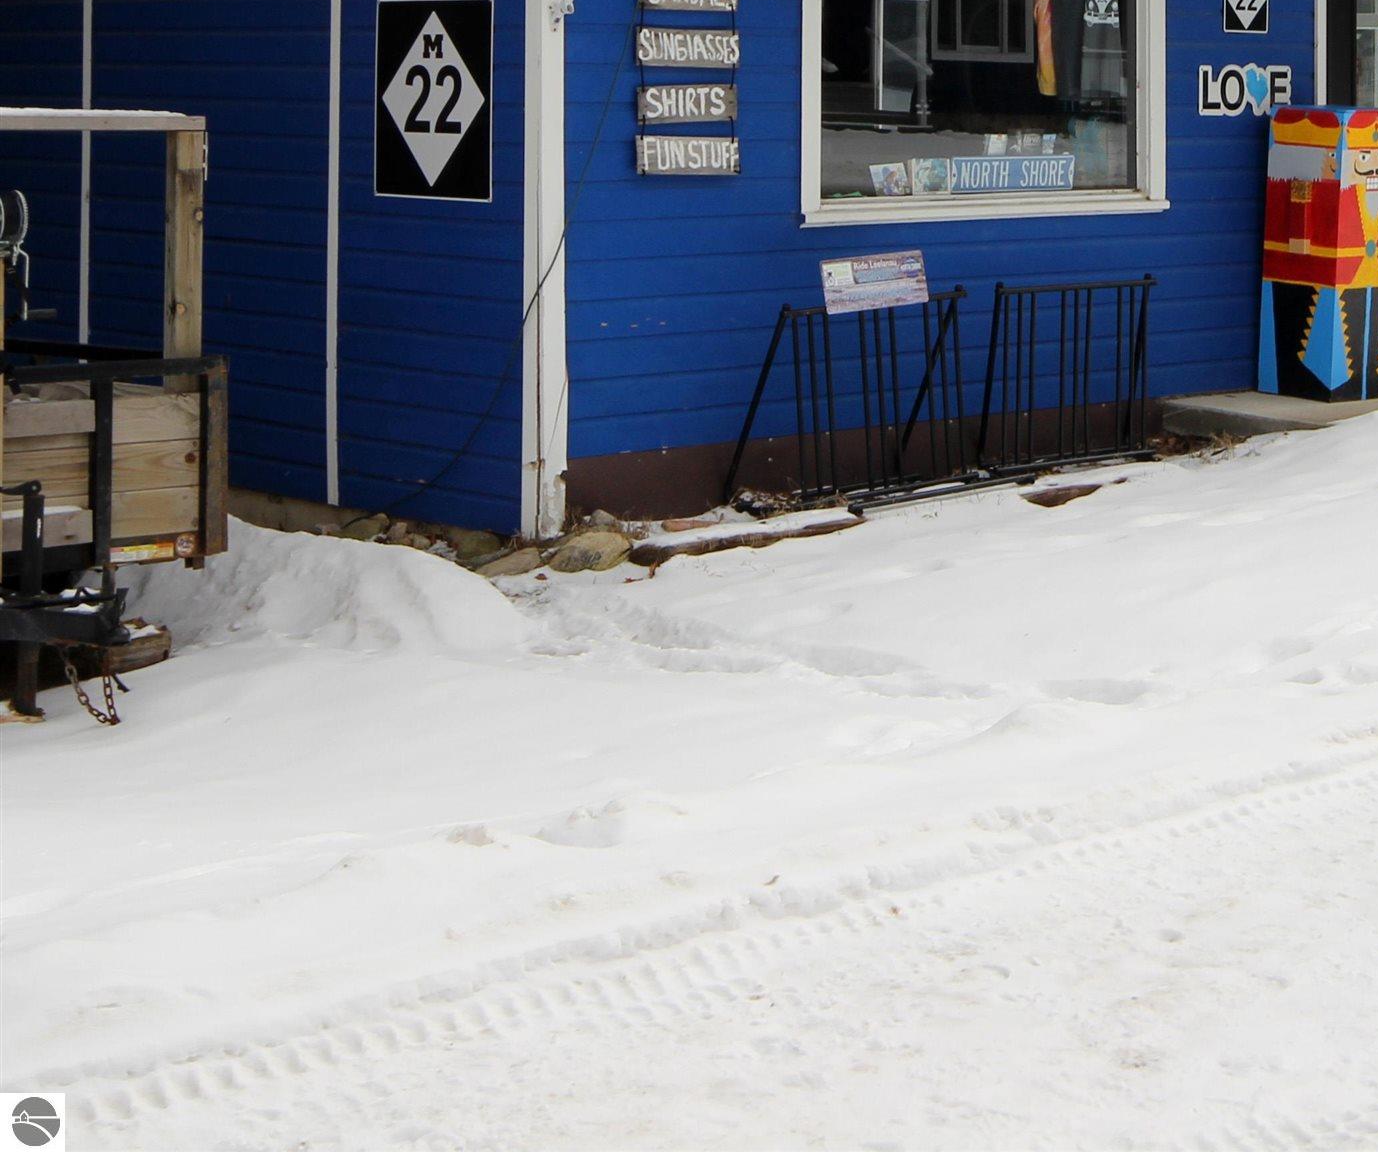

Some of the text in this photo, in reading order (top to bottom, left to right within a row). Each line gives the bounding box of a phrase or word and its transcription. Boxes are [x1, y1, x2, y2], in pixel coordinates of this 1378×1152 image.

[422, 34, 443, 59] M
[404, 64, 462, 134] 22
[645, 86, 726, 118] SHIRTS
[643, 137, 739, 172] FUN STUFF
[960, 159, 1066, 189] NORTH SHORE
